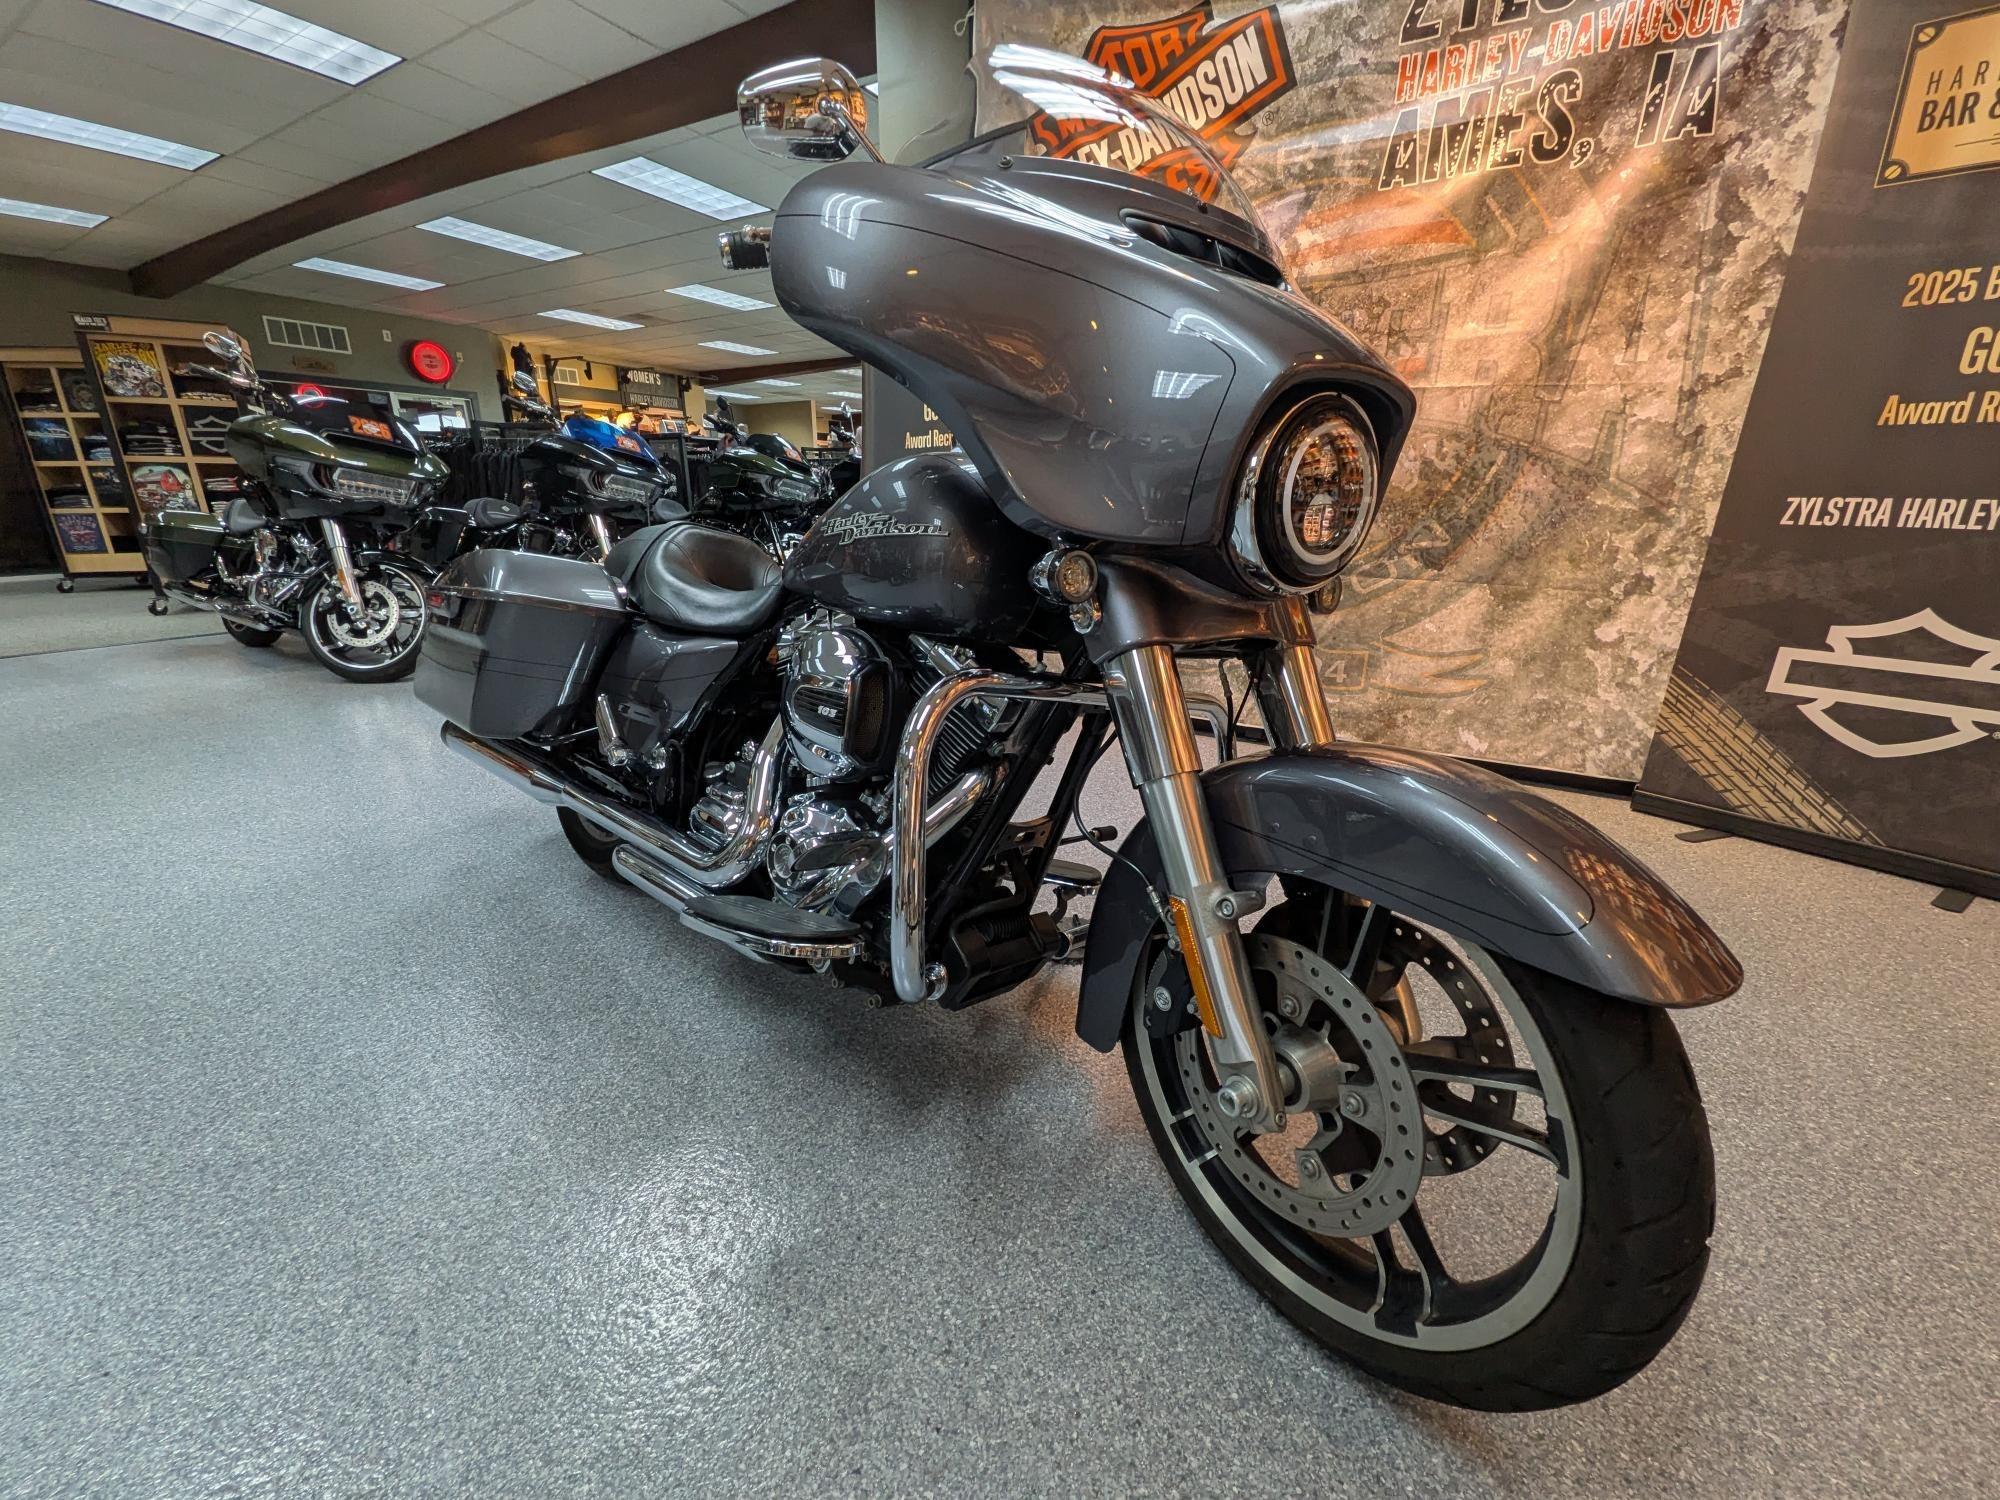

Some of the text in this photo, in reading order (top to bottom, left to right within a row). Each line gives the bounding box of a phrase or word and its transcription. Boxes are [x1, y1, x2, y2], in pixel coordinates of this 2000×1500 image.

[1394, 0, 1744, 104] HARLEY-DAVIDSON
[1378, 42, 1721, 191] AMES, IA
[1917, 92, 1980, 133] BAR
[1902, 267, 1982, 307] 2025
[1877, 391, 1975, 426] Award
[905, 430, 931, 449] Award
[839, 516, 949, 545] Davidson
[1780, 498, 1893, 527] ZYLSTRA
